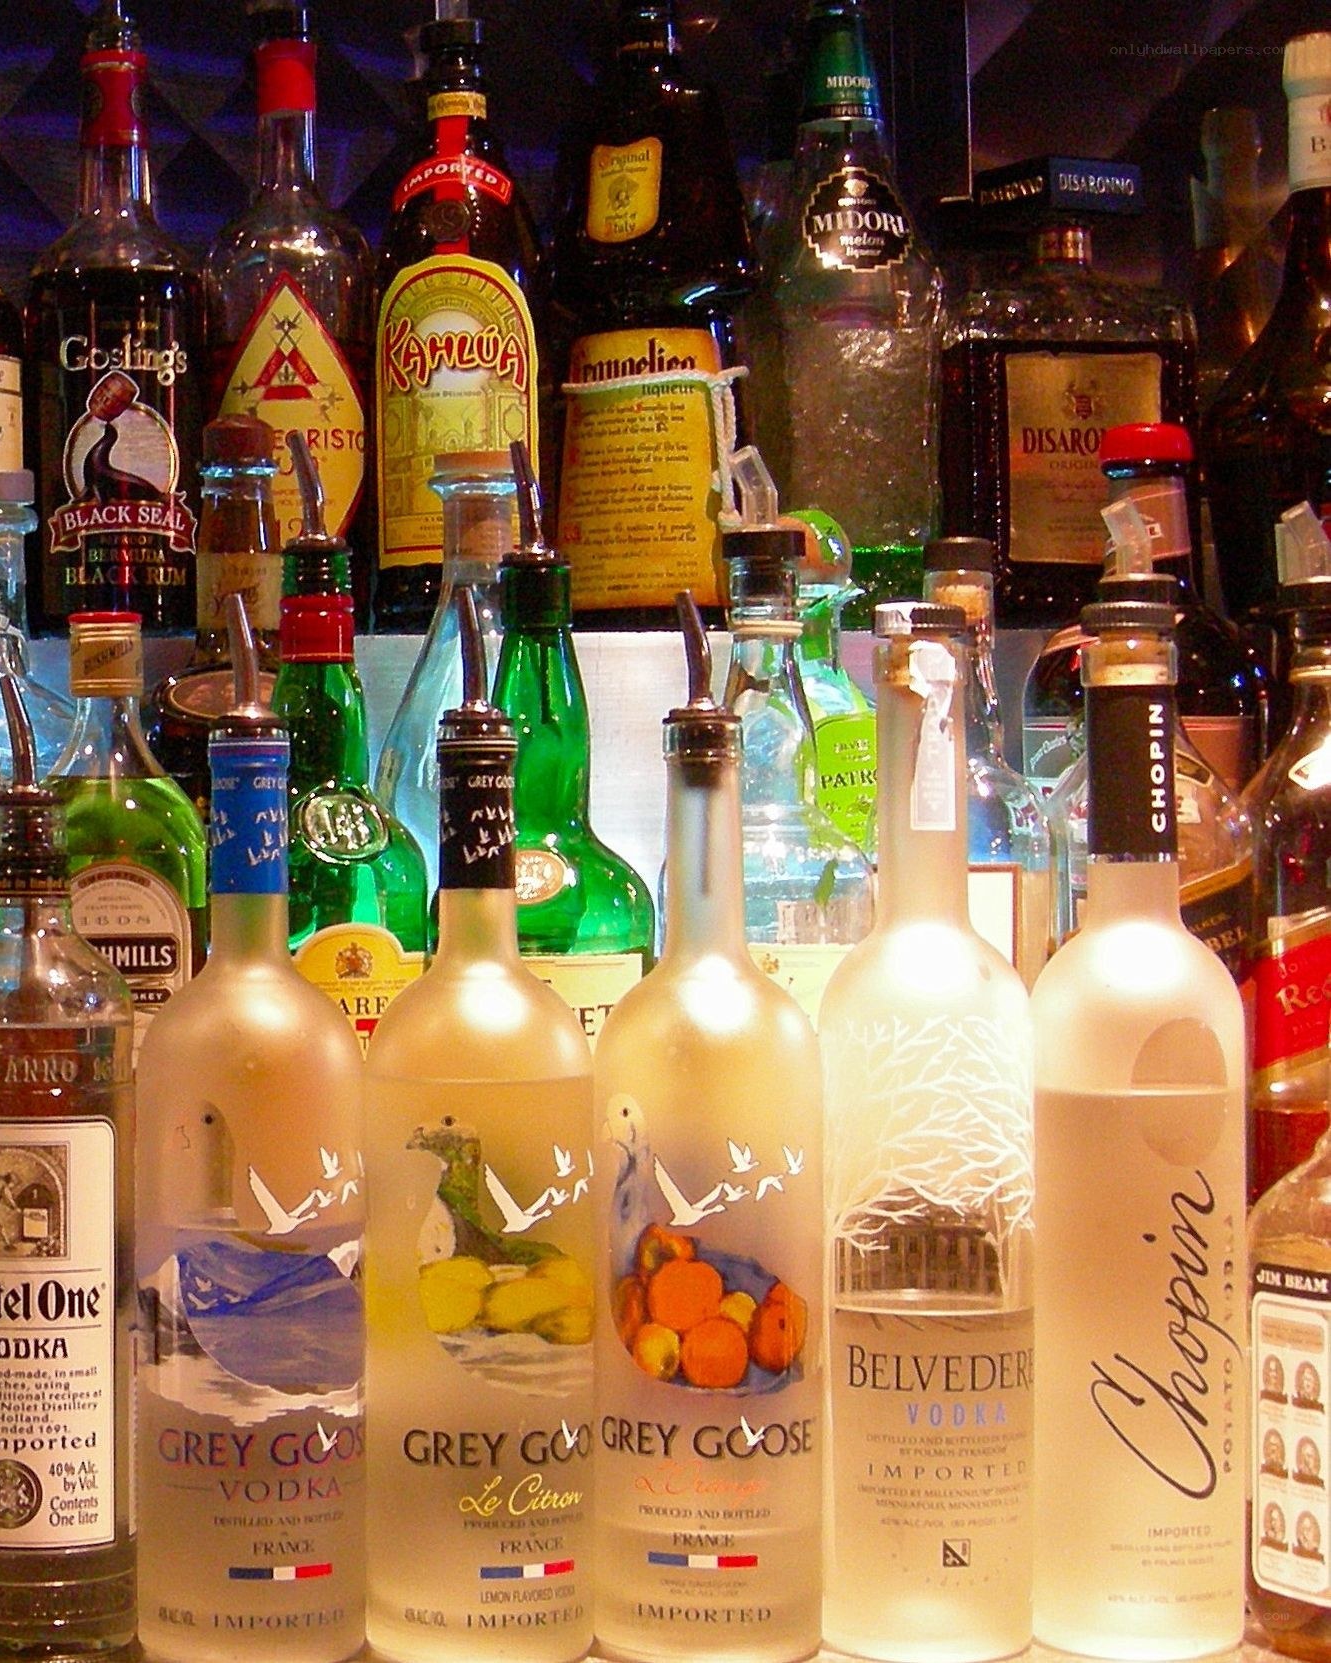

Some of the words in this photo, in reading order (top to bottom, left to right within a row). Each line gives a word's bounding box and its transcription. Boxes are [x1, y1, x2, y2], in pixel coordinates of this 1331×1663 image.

[827, 75, 873, 90] MIDORI
[599, 149, 650, 168] Original
[402, 162, 498, 193] IMPORTED
[1059, 173, 1135, 197] DISARONNO
[812, 210, 910, 239] MIDORI
[839, 232, 885, 246] melon
[60, 334, 188, 386] Gosling's
[383, 318, 528, 393] KAHLÚA
[641, 383, 695, 398] liqueur
[272, 428, 365, 453] ECRISTO
[1022, 426, 1103, 456] DISARO
[1049, 459, 1099, 470] ORIGIN
[65, 506, 132, 531] BLACK
[137, 506, 185, 531] SEAL
[88, 548, 166, 563] BERMUDA
[65, 567, 139, 585] BLACK
[147, 567, 187, 586] RUM
[1148, 703, 1166, 833] CHOPIN
[468, 775, 494, 788] GREY
[1207, 924, 1248, 953] BEL
[94, 944, 173, 968] HMILLS
[337, 996, 389, 1017] ARE
[1257, 1268, 1281, 1287] JIM
[1285, 1271, 1329, 1294] BEAM
[37, 1278, 100, 1322] One
[1090, 1168, 1243, 1501] Chopin
[69, 1366, 98, 1378] small
[34, 1380, 71, 1393] using
[48, 1391, 92, 1404] recipes
[0, 1402, 40, 1413] Nolet
[42, 1400, 99, 1414] Distillery
[907, 1402, 1008, 1428] VODKA
[1223, 1357, 1233, 1475] POTATO
[158, 1427, 254, 1467] GREY
[403, 1428, 508, 1468] GREY
[520, 1423, 592, 1466] GOO
[601, 1415, 679, 1457] GREY
[692, 1418, 813, 1460] GOOSE
[48, 1461, 75, 1478] 40%
[867, 1459, 1027, 1482] IMPORTED
[63, 1477, 77, 1493] by
[78, 1475, 99, 1491] Vol.
[219, 1476, 342, 1503] VODKA
[458, 1474, 504, 1517] Le
[508, 1472, 583, 1515] Citron
[49, 1495, 99, 1512] Contents
[638, 1504, 693, 1518] PRODUCED
[696, 1508, 720, 1519] AND
[722, 1508, 770, 1521] BOTTLED
[48, 1511, 74, 1528] One
[78, 1511, 99, 1526] liter
[213, 1516, 273, 1528] DISTILLED
[274, 1515, 300, 1527] AND
[672, 1532, 736, 1548] FRANCE
[1147, 1524, 1212, 1539] IMPORTED
[253, 1539, 315, 1556] FRANCE
[499, 1537, 564, 1554] FRANCE
[480, 1590, 511, 1604] LEMON
[213, 1607, 346, 1630] IMPORTED
[466, 1605, 584, 1629] IMPORTED
[636, 1602, 772, 1624] IMPORTED
